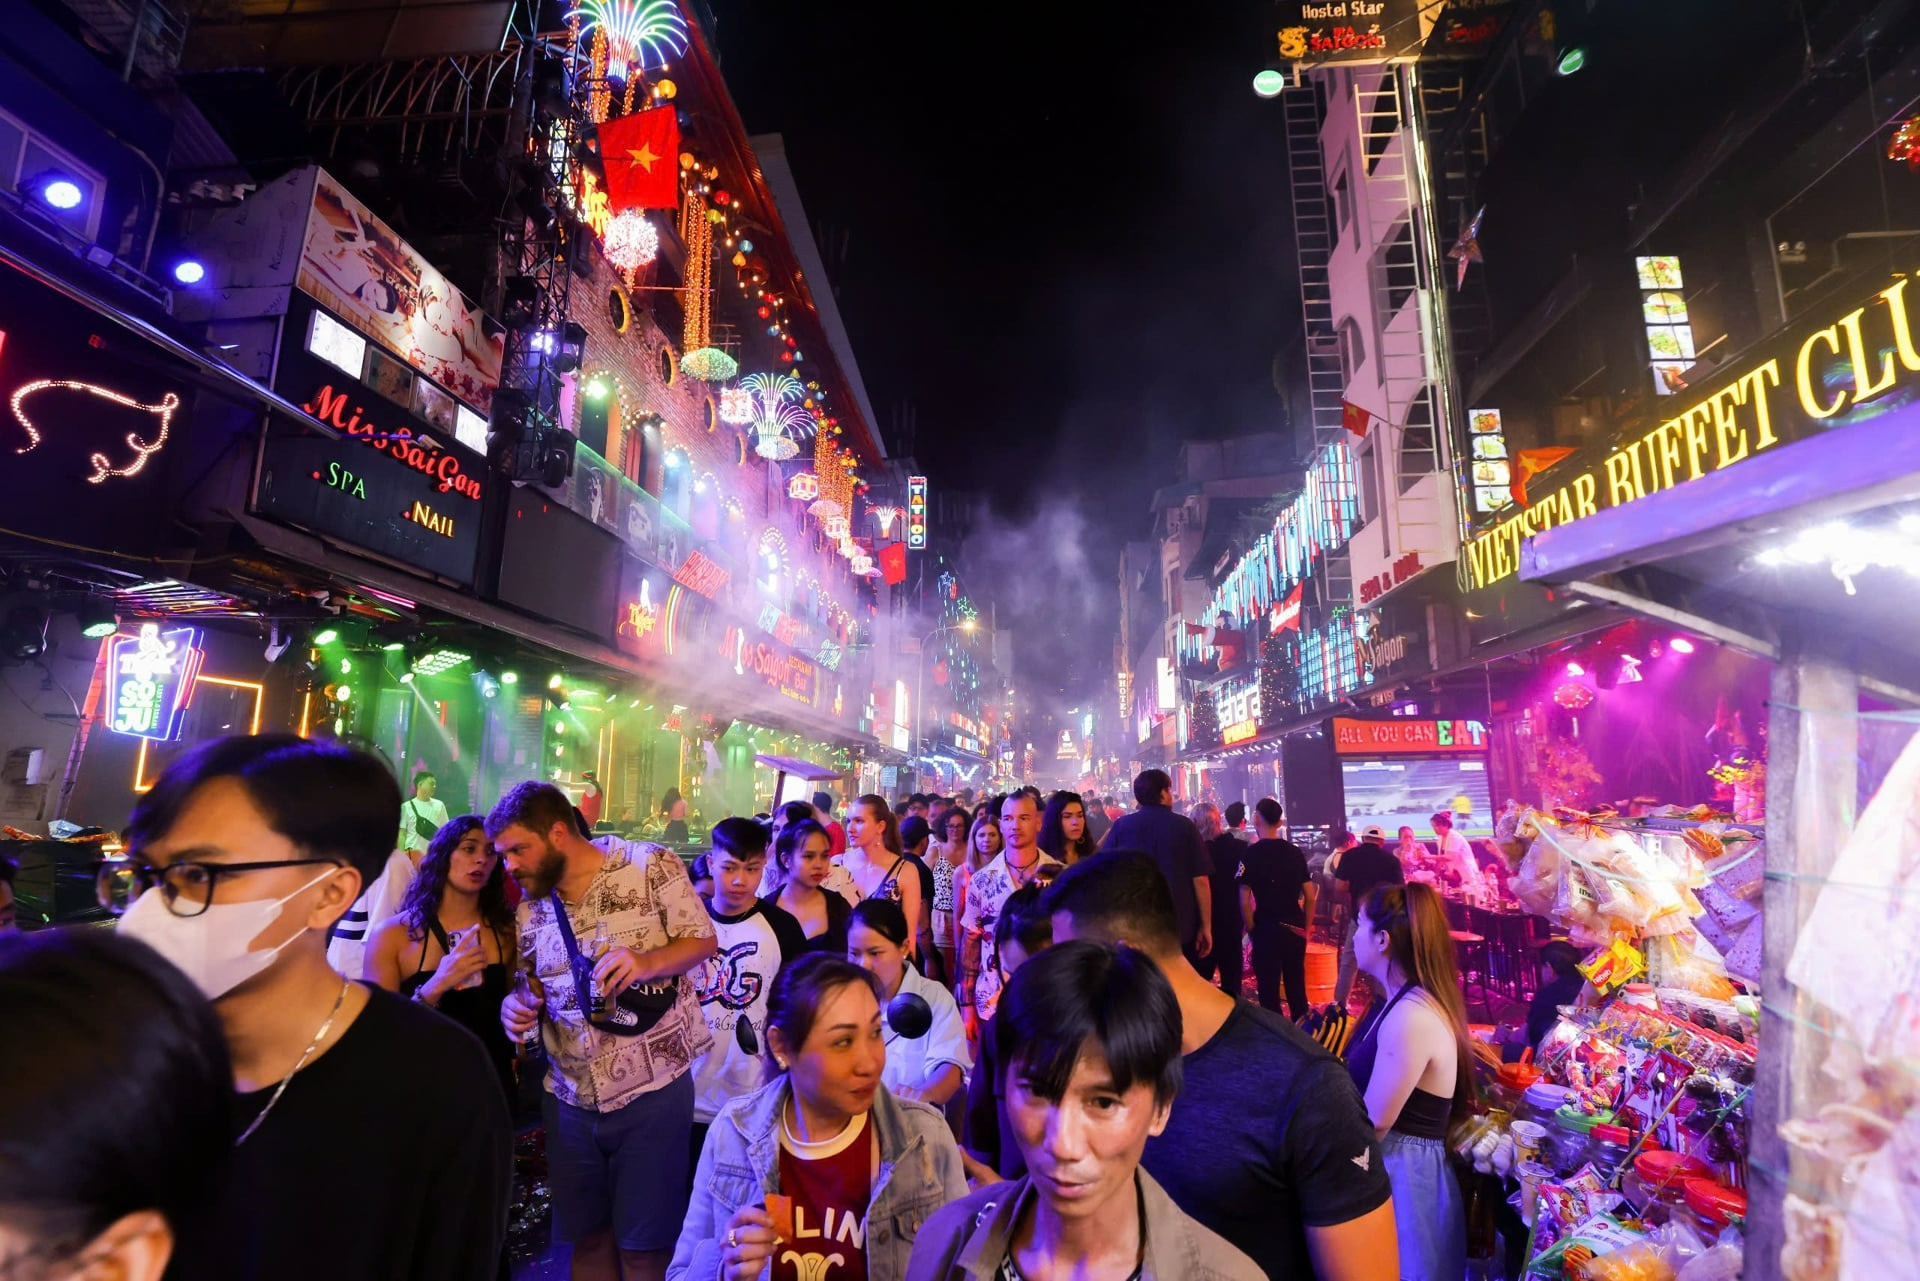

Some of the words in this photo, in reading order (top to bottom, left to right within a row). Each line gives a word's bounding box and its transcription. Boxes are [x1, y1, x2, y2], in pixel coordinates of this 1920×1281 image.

[1302, 3, 1346, 19] Hostel
[1351, 1, 1385, 15] Star
[304, 385, 388, 449] Miss
[327, 462, 366, 500] SPA
[1468, 473, 1597, 590] VIETSTAR
[1604, 358, 1780, 507] BUFFET
[910, 484, 924, 545] TATTOO
[1360, 575, 1382, 604] SPA
[754, 643, 790, 687] Saigon
[1118, 680, 1127, 719] HOTEL
[1340, 728, 1363, 744] ALL
[1372, 727, 1399, 743] YOU
[1404, 725, 1434, 742] CAN
[1437, 719, 1487, 746] EAT
[773, 1205, 866, 1250] LIN
